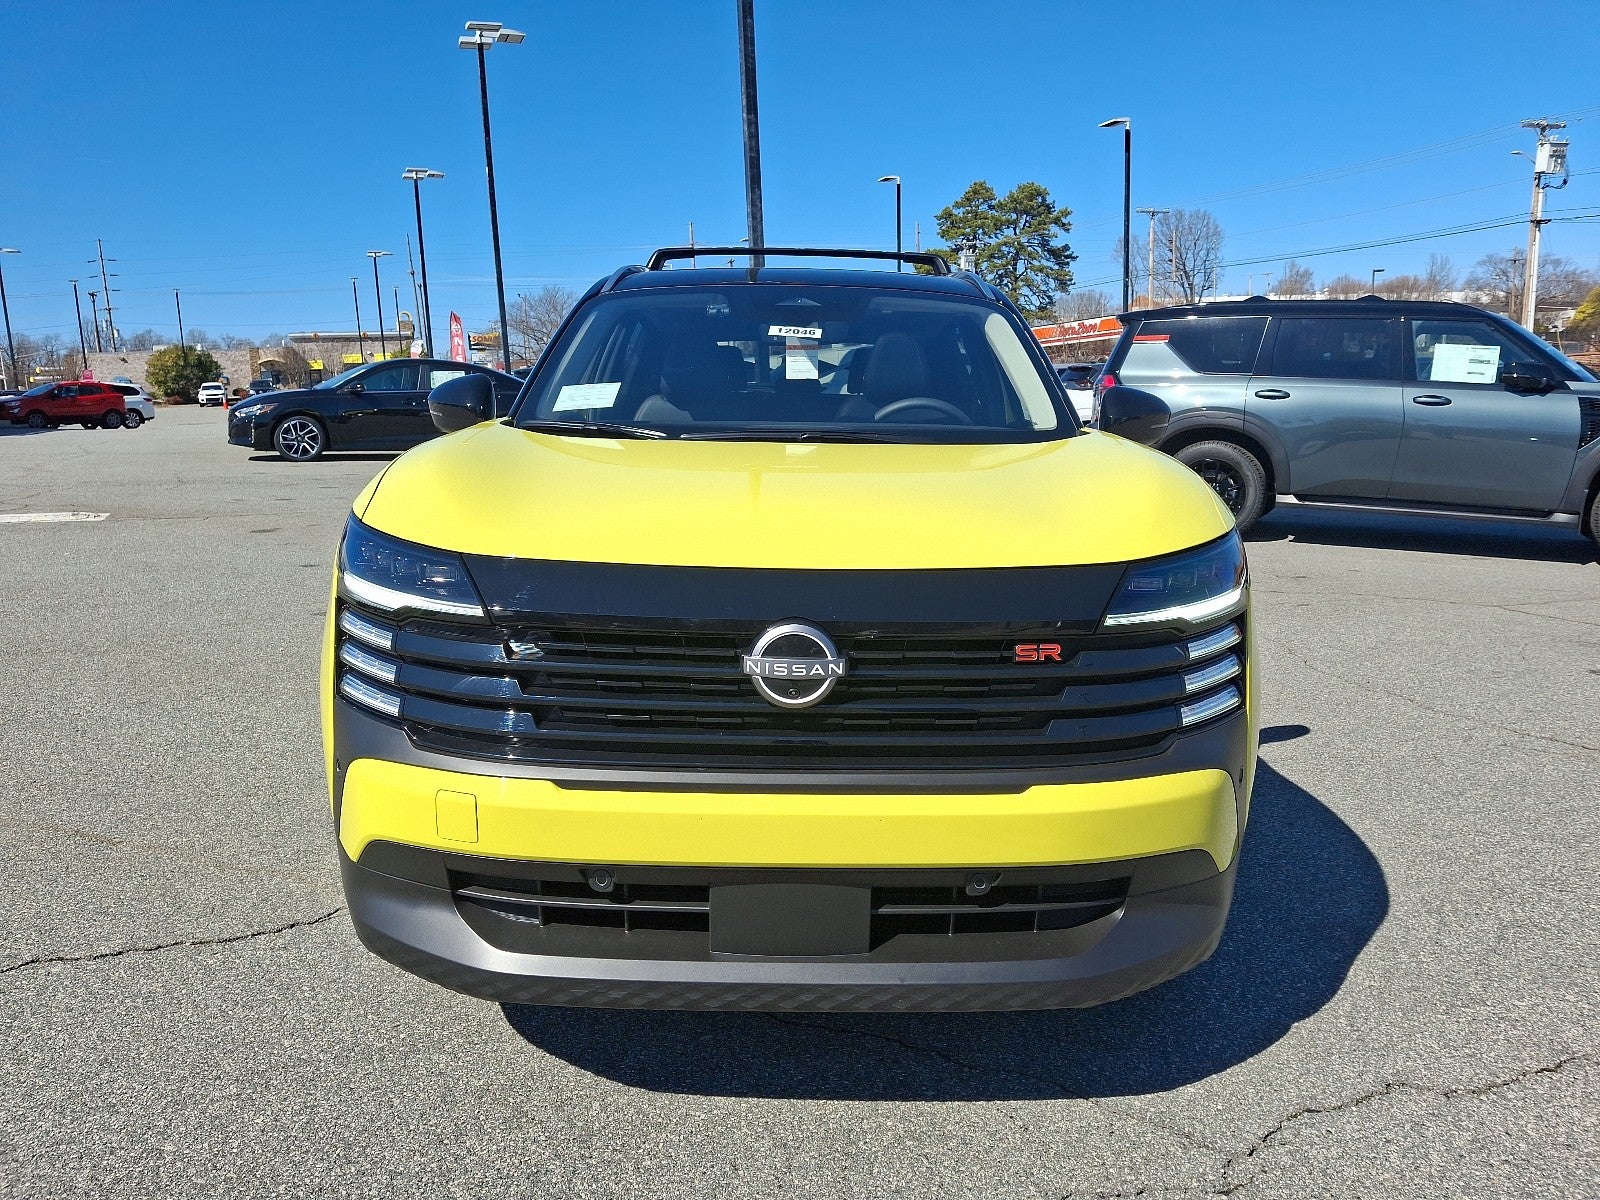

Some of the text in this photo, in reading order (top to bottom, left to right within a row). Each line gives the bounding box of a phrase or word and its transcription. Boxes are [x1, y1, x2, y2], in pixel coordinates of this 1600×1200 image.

[778, 327, 816, 336] 12046
[1015, 643, 1062, 662] SR
[746, 660, 843, 676] NISSAN
